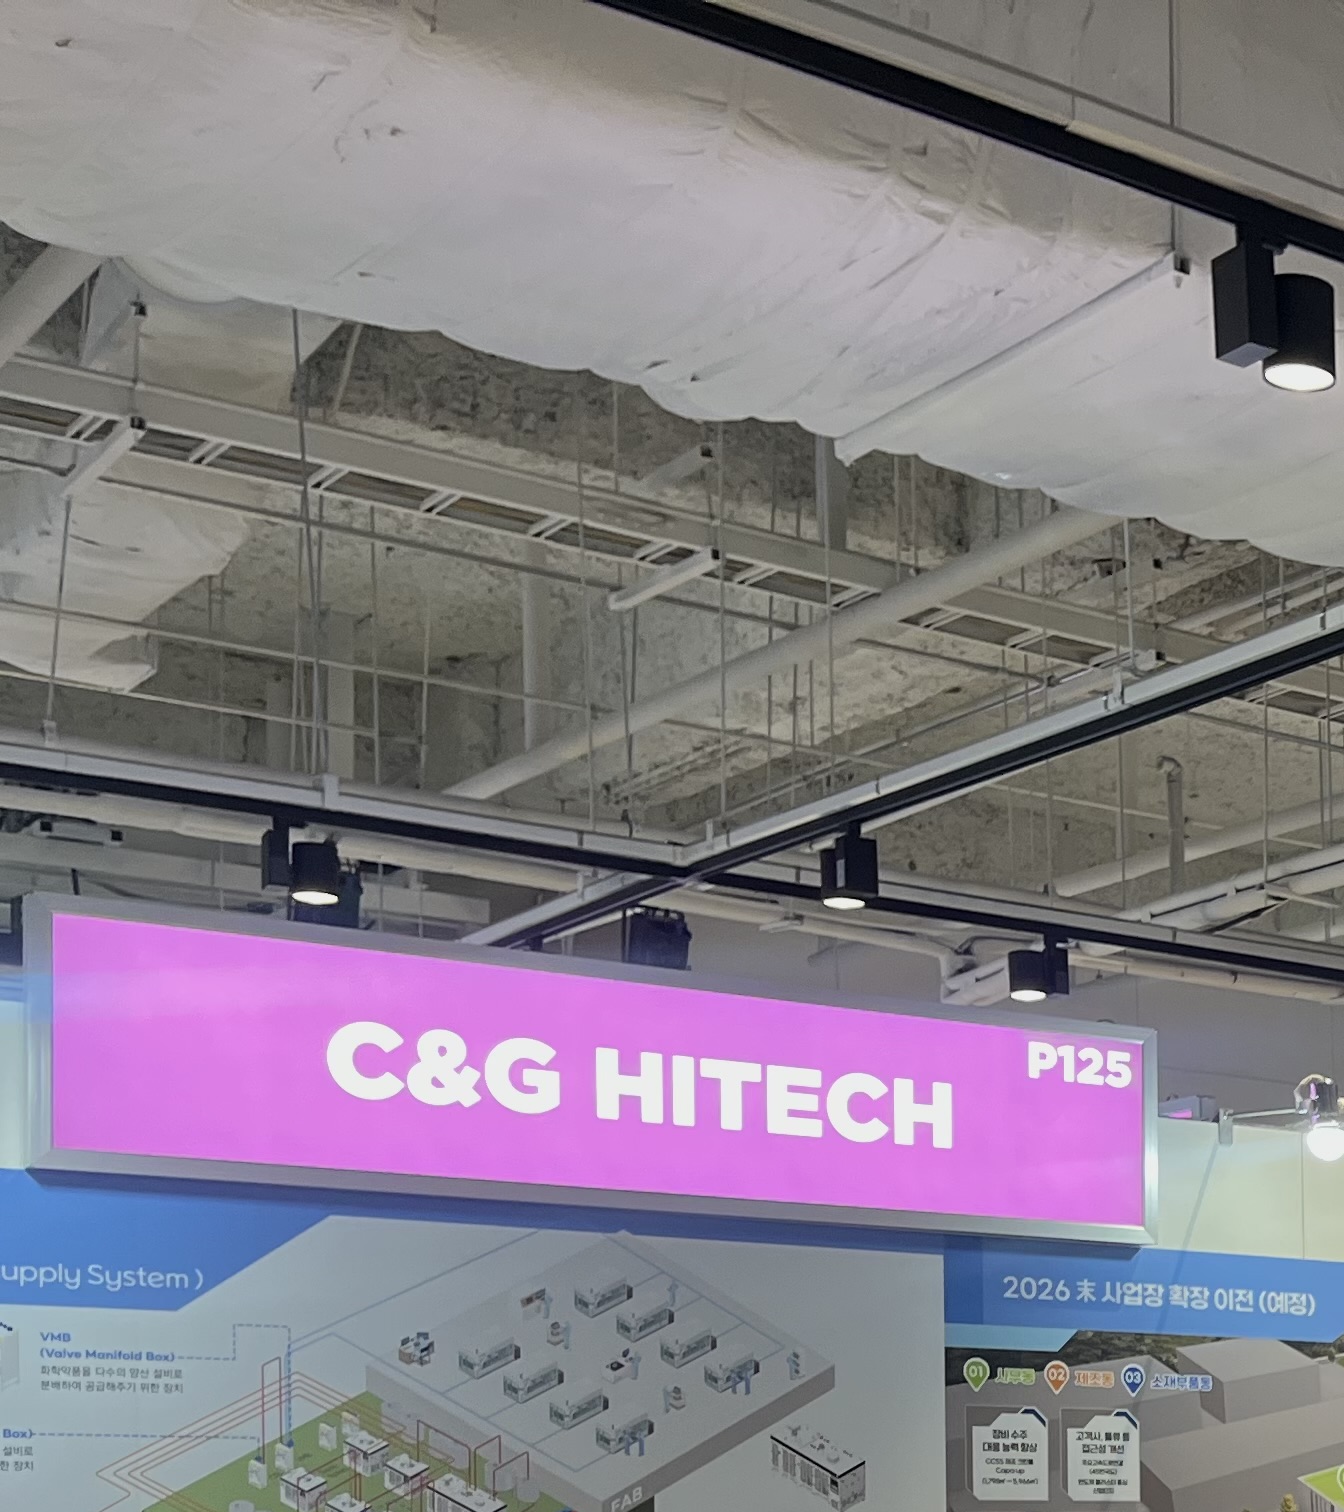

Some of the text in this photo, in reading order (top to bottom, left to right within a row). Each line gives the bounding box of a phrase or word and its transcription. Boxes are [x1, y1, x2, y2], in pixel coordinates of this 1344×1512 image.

[1027, 1041, 1132, 1090] P125
[326, 1020, 953, 1149] C&G HITECH
[88, 1263, 190, 1292] System
[1003, 1275, 1071, 1303] 2026
[1101, 1280, 1165, 1308] 사업장
[1169, 1284, 1211, 1311] 확장
[1214, 1288, 1255, 1313] 이전
[1258, 1288, 1317, 1317] (예정)
[40, 1332, 73, 1342] VMB
[40, 1349, 177, 1362] (Valve Manifold Box)
[1049, 1367, 1067, 1380] 02
[1125, 1370, 1143, 1383] 03
[3, 1428, 34, 1439] Box)
